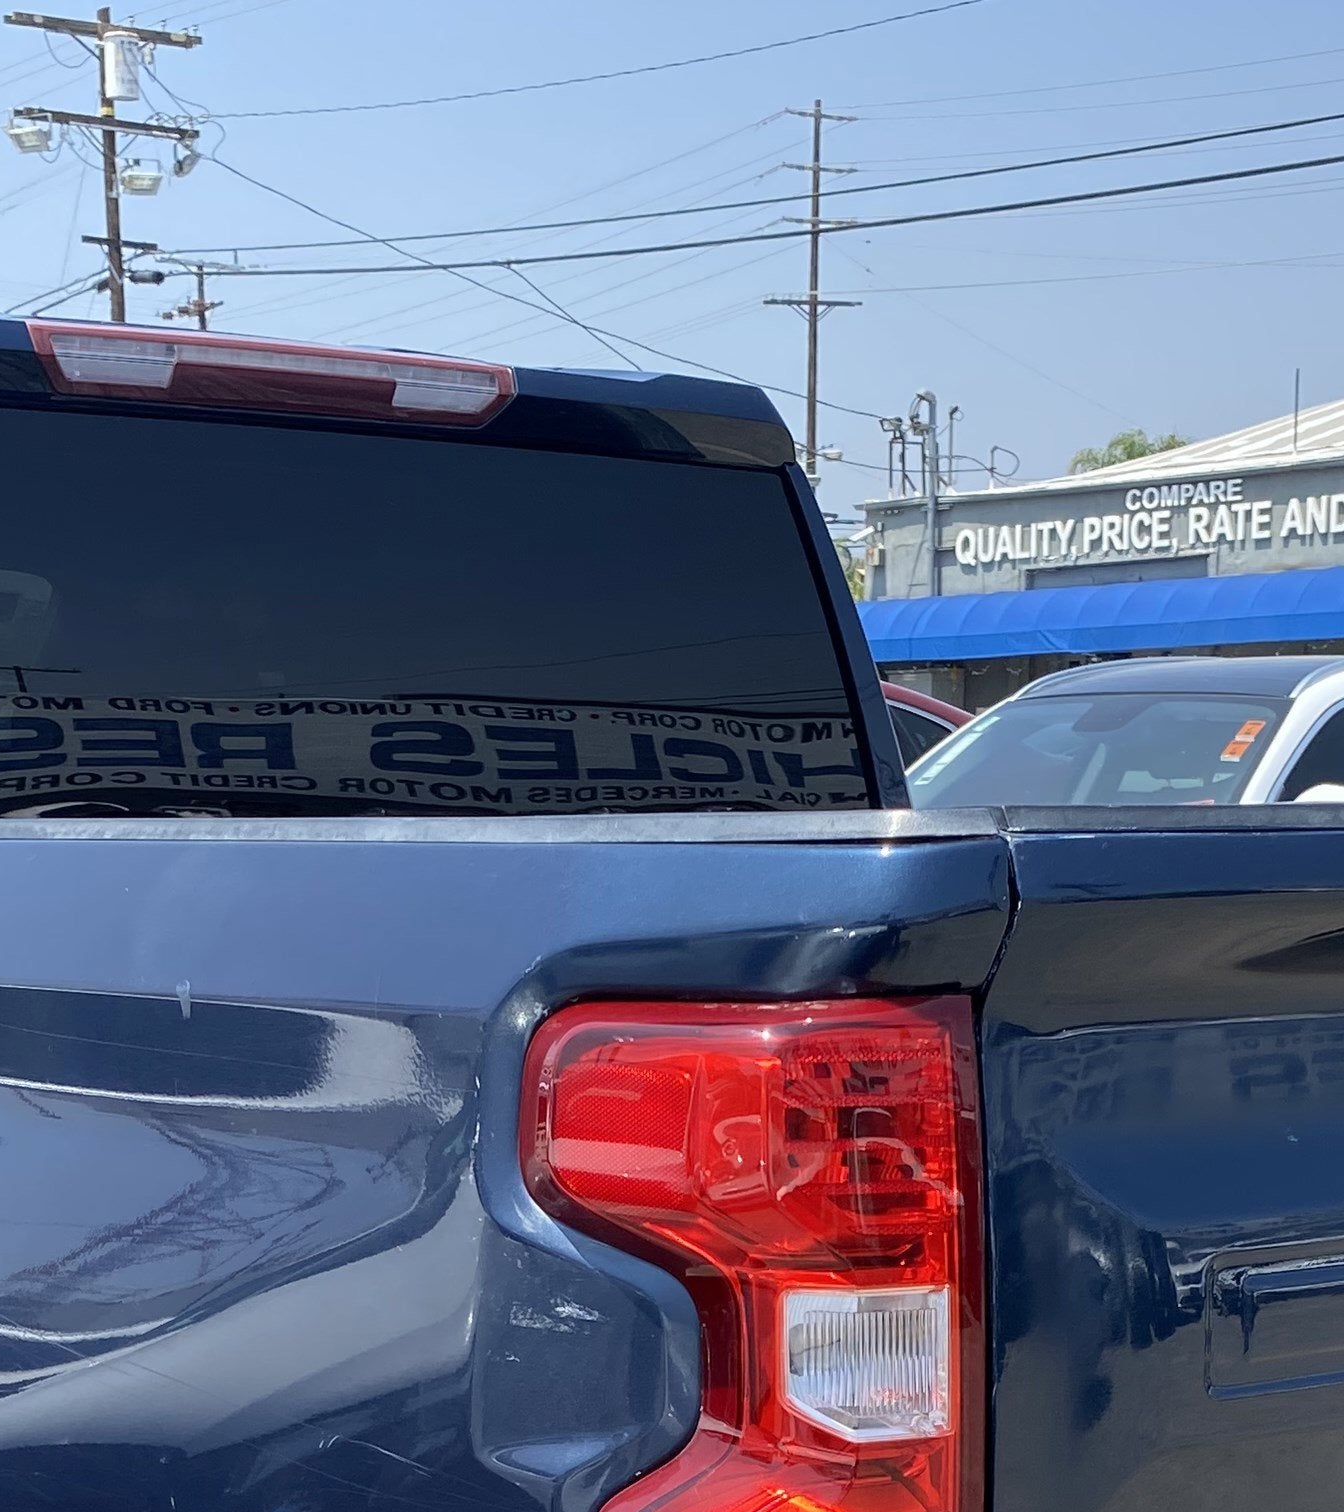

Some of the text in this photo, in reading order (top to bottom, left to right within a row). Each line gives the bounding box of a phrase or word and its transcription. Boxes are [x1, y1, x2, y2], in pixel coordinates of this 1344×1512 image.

[1125, 478, 1243, 511] COMPARE
[954, 518, 1077, 567] QUALITY,
[1083, 510, 1178, 555] PRICE,
[1188, 500, 1272, 545] RATE
